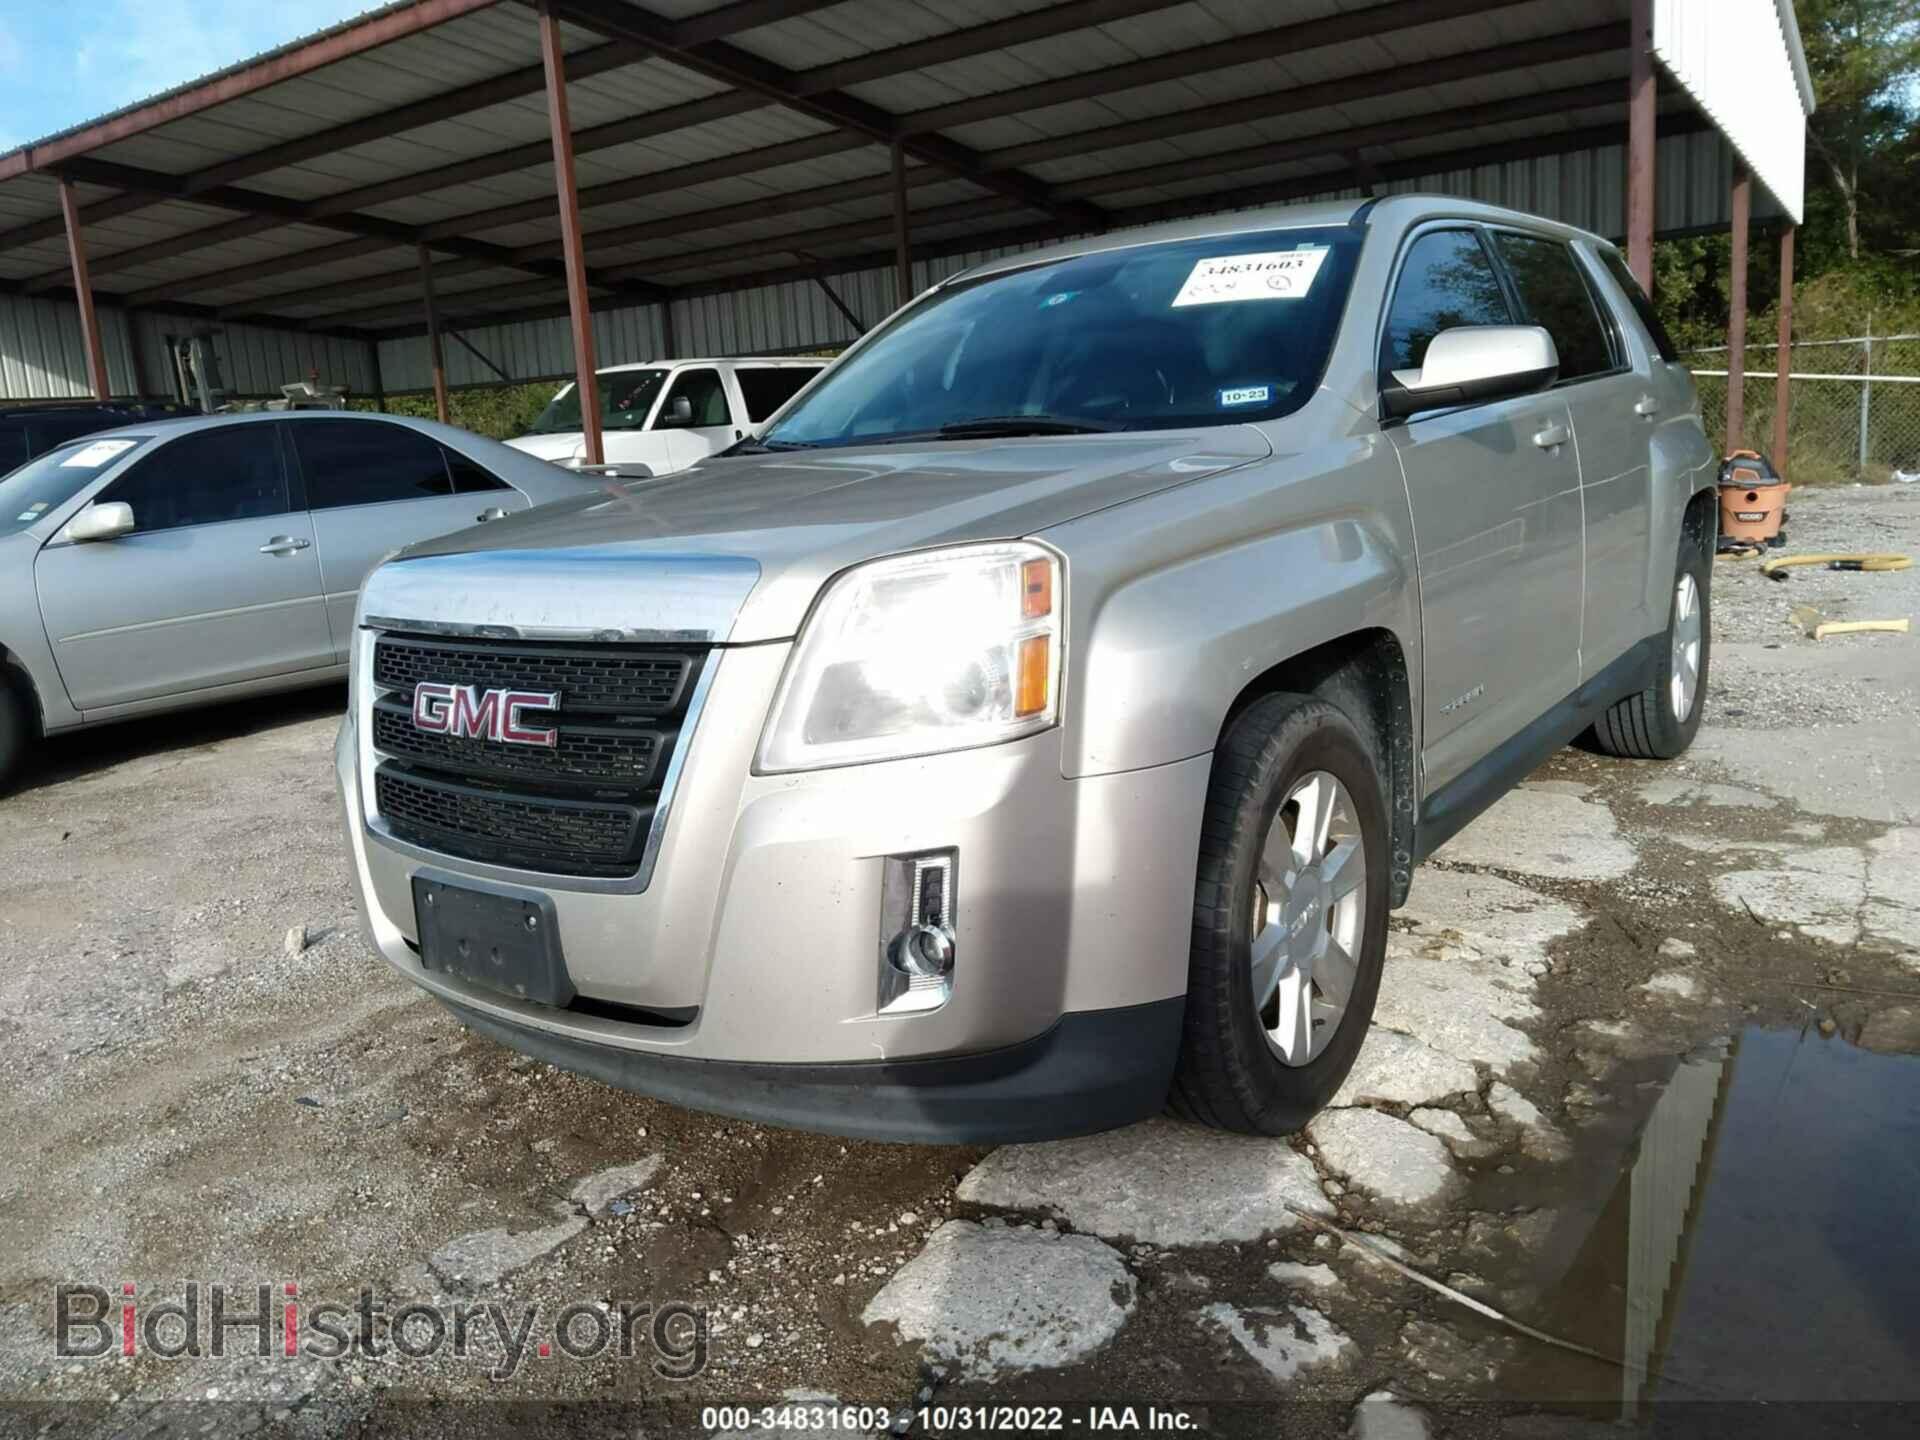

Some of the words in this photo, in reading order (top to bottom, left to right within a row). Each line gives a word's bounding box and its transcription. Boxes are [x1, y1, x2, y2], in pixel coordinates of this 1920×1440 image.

[1207, 259, 1304, 275] 34831603
[1226, 389, 1267, 402] 10-23
[413, 681, 562, 748] GMC
